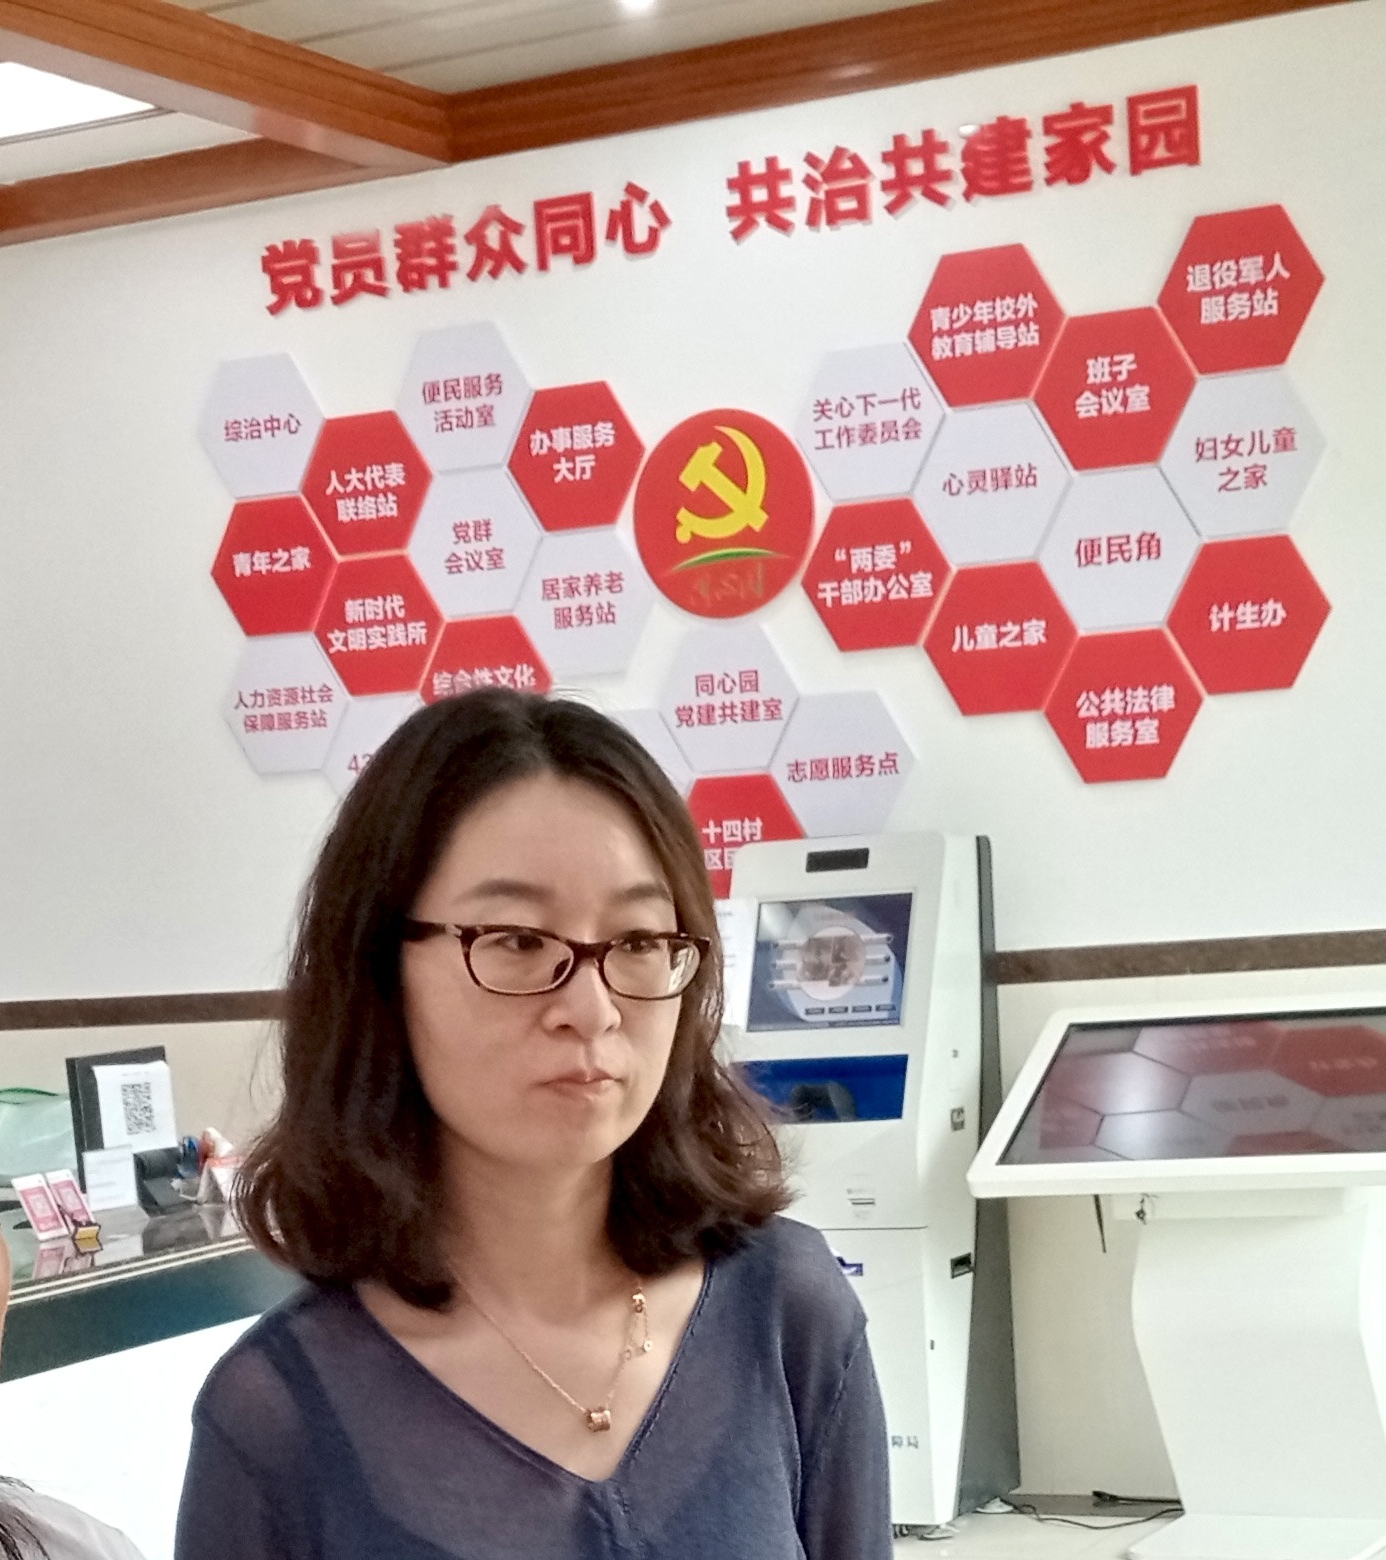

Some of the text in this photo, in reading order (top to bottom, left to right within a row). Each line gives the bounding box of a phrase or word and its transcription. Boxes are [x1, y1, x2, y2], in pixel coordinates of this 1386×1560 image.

[725, 84, 1200, 242] 共治共建家园
[261, 181, 671, 317] 党员群众同心
[1186, 252, 1290, 294] 退役军人
[930, 296, 1038, 332] 青少年校外
[1200, 290, 1279, 324] 服务站
[931, 323, 1040, 359] 教育辅导站
[1086, 354, 1137, 385] 班子
[421, 372, 503, 405] 便民服务
[813, 387, 921, 422] 关心下一代
[1075, 384, 1151, 417] 会议室
[223, 412, 302, 443] 综治中心
[434, 402, 496, 433] 活动室
[530, 422, 616, 455] 办事服务
[815, 418, 923, 451] 工作委员会
[1195, 427, 1298, 463] 妇女儿童
[327, 462, 406, 494] 人大代表
[553, 454, 596, 484] 大厅
[943, 464, 1038, 494] 心灵驿站
[1218, 464, 1268, 492] 之家
[337, 492, 398, 522] 联络站
[452, 518, 493, 545] 党群
[232, 545, 311, 576] 青年之家
[445, 547, 505, 575] 会议室
[1075, 531, 1163, 566] 便民角
[541, 570, 625, 602] 居家养老
[817, 572, 933, 607] 干部办公室
[344, 595, 405, 622] 新时代
[553, 601, 616, 630] 服务站
[1209, 601, 1287, 633] 计生办
[328, 620, 427, 653] 文明实践所
[952, 620, 1046, 652] 儿童之家
[234, 683, 333, 710] 人力资源社会
[694, 671, 759, 698] 同心园
[675, 697, 783, 729] 党建共建室
[1076, 685, 1176, 719] 公共法律
[244, 709, 328, 733] 保障服务站
[1086, 718, 1160, 748] 服务室
[787, 751, 900, 783] 志愿服务点
[702, 817, 763, 844] 十四村
